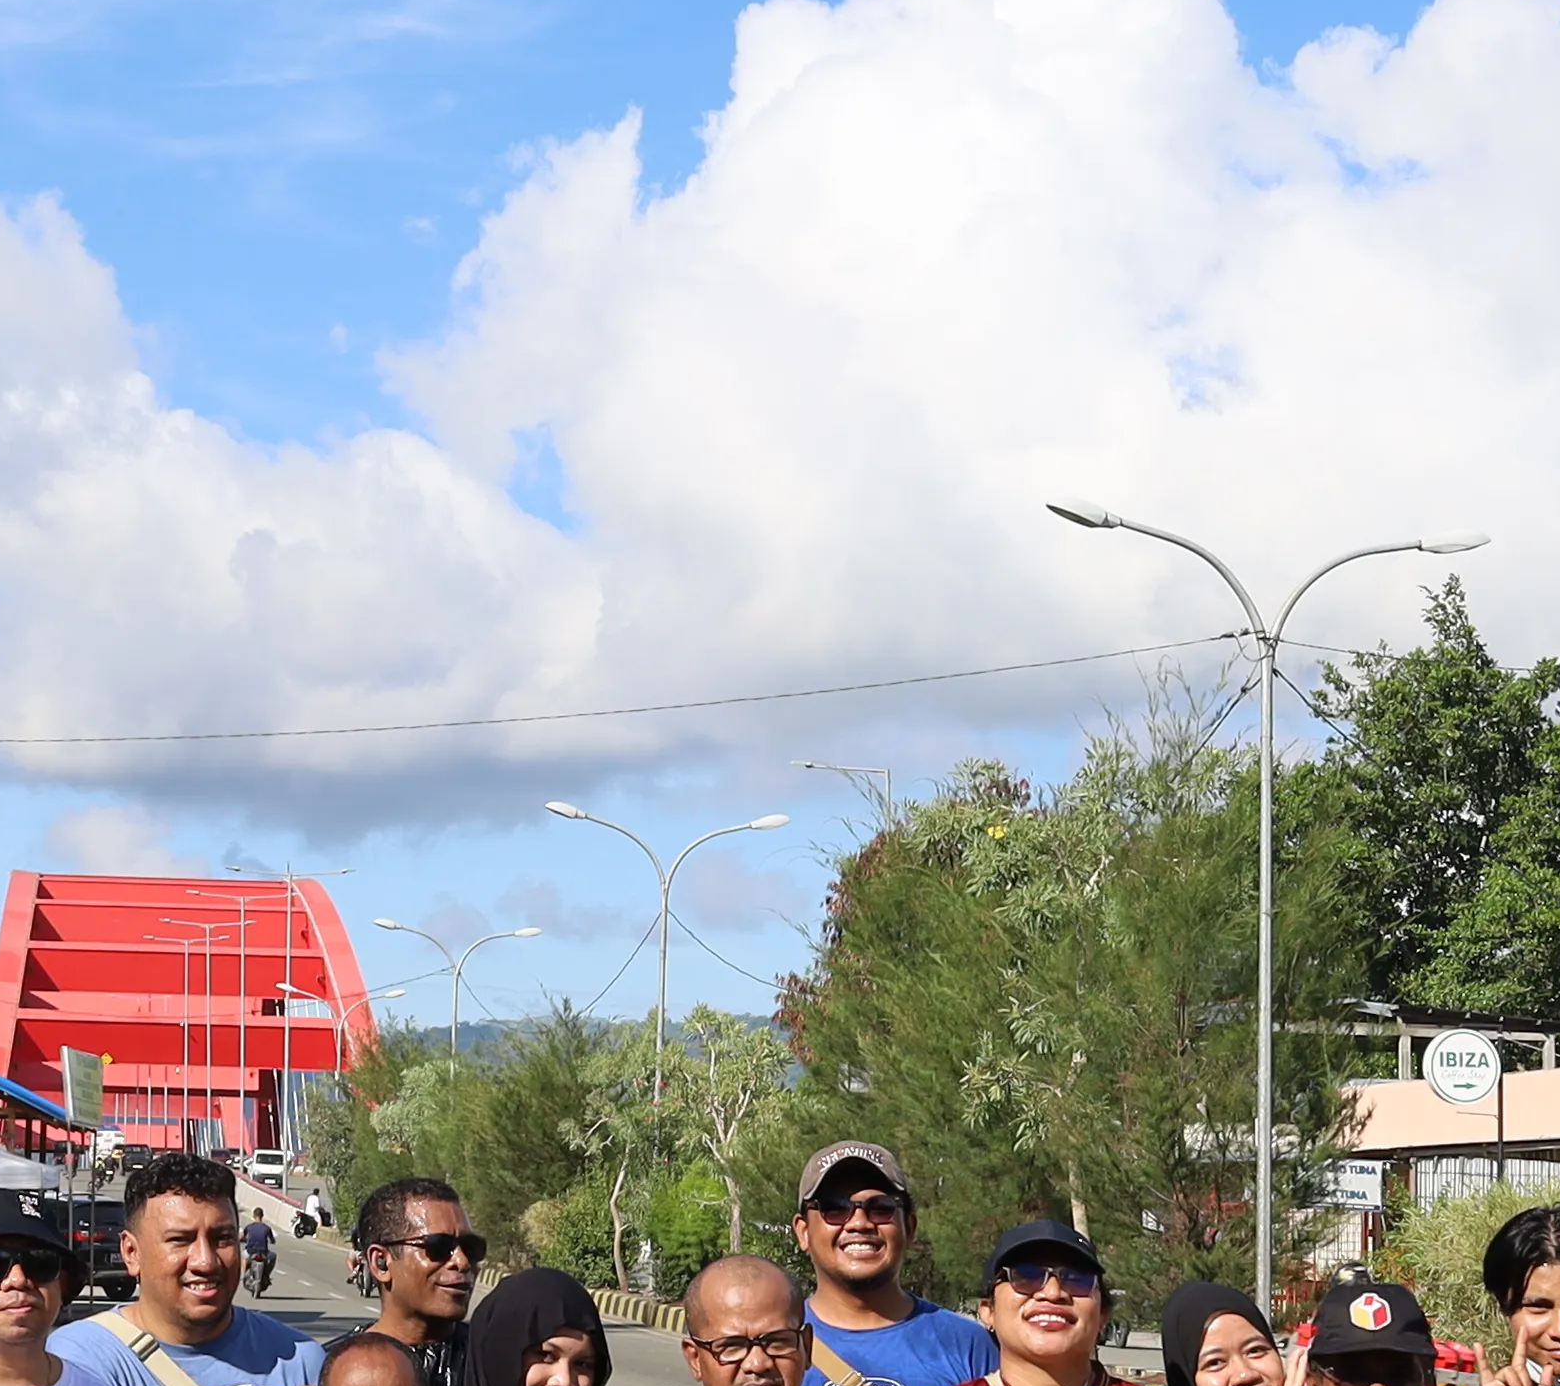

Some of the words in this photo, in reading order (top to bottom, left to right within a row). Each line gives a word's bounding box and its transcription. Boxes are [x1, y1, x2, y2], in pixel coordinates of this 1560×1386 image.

[1439, 1052, 1490, 1069] IBIZA
[1348, 1165, 1378, 1176] TUNA
[1341, 1190, 1368, 1201] TUNA
